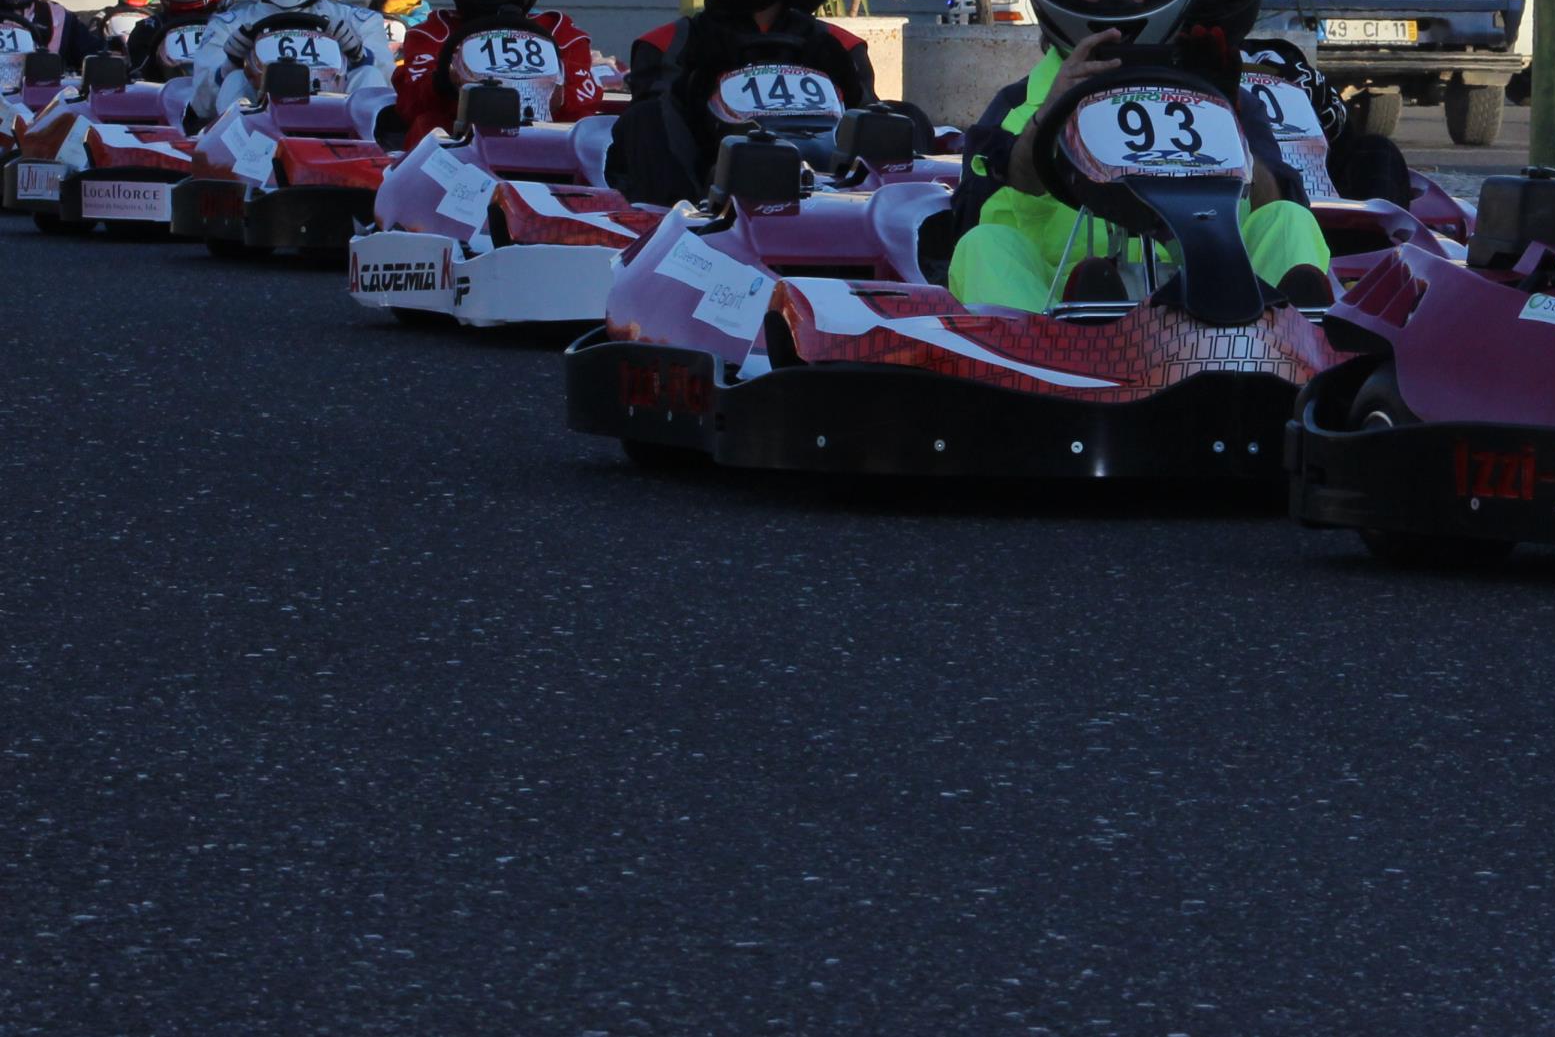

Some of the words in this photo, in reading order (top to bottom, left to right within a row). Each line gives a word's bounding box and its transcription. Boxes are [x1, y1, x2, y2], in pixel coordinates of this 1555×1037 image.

[278, 36, 320, 62] 64
[480, 37, 545, 67] 158
[742, 74, 826, 107] 149
[1240, 75, 1281, 86] INDY
[1117, 101, 1203, 153] 93
[350, 252, 436, 293] ACADEMIA
